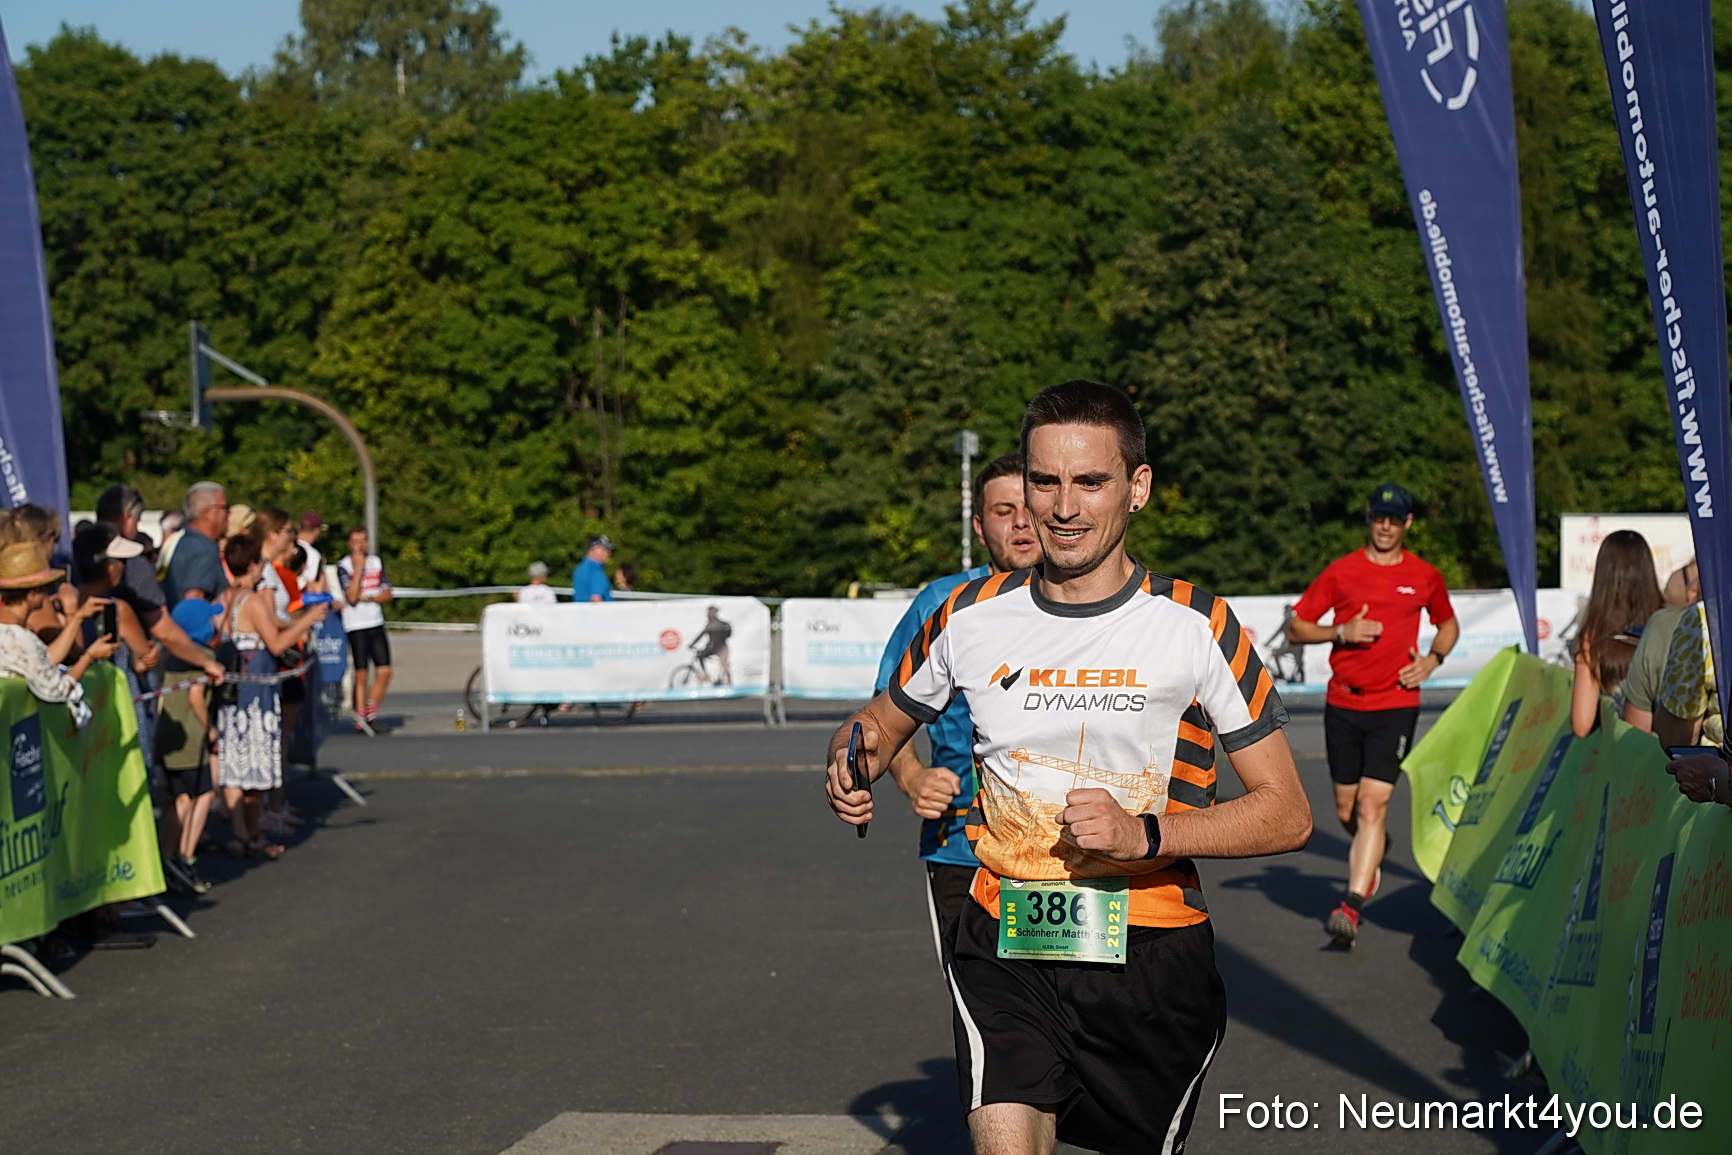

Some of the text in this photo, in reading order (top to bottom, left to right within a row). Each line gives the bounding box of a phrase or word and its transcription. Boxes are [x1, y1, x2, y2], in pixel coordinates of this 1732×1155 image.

[1029, 668, 1148, 688] KLEBL
[1023, 692, 1147, 712] DYNAMICS
[1007, 902, 1017, 938] RUN
[1026, 891, 1091, 926] 386
[1016, 927, 1107, 940] Schönherr Matthas
[1107, 900, 1121, 948] 2022
